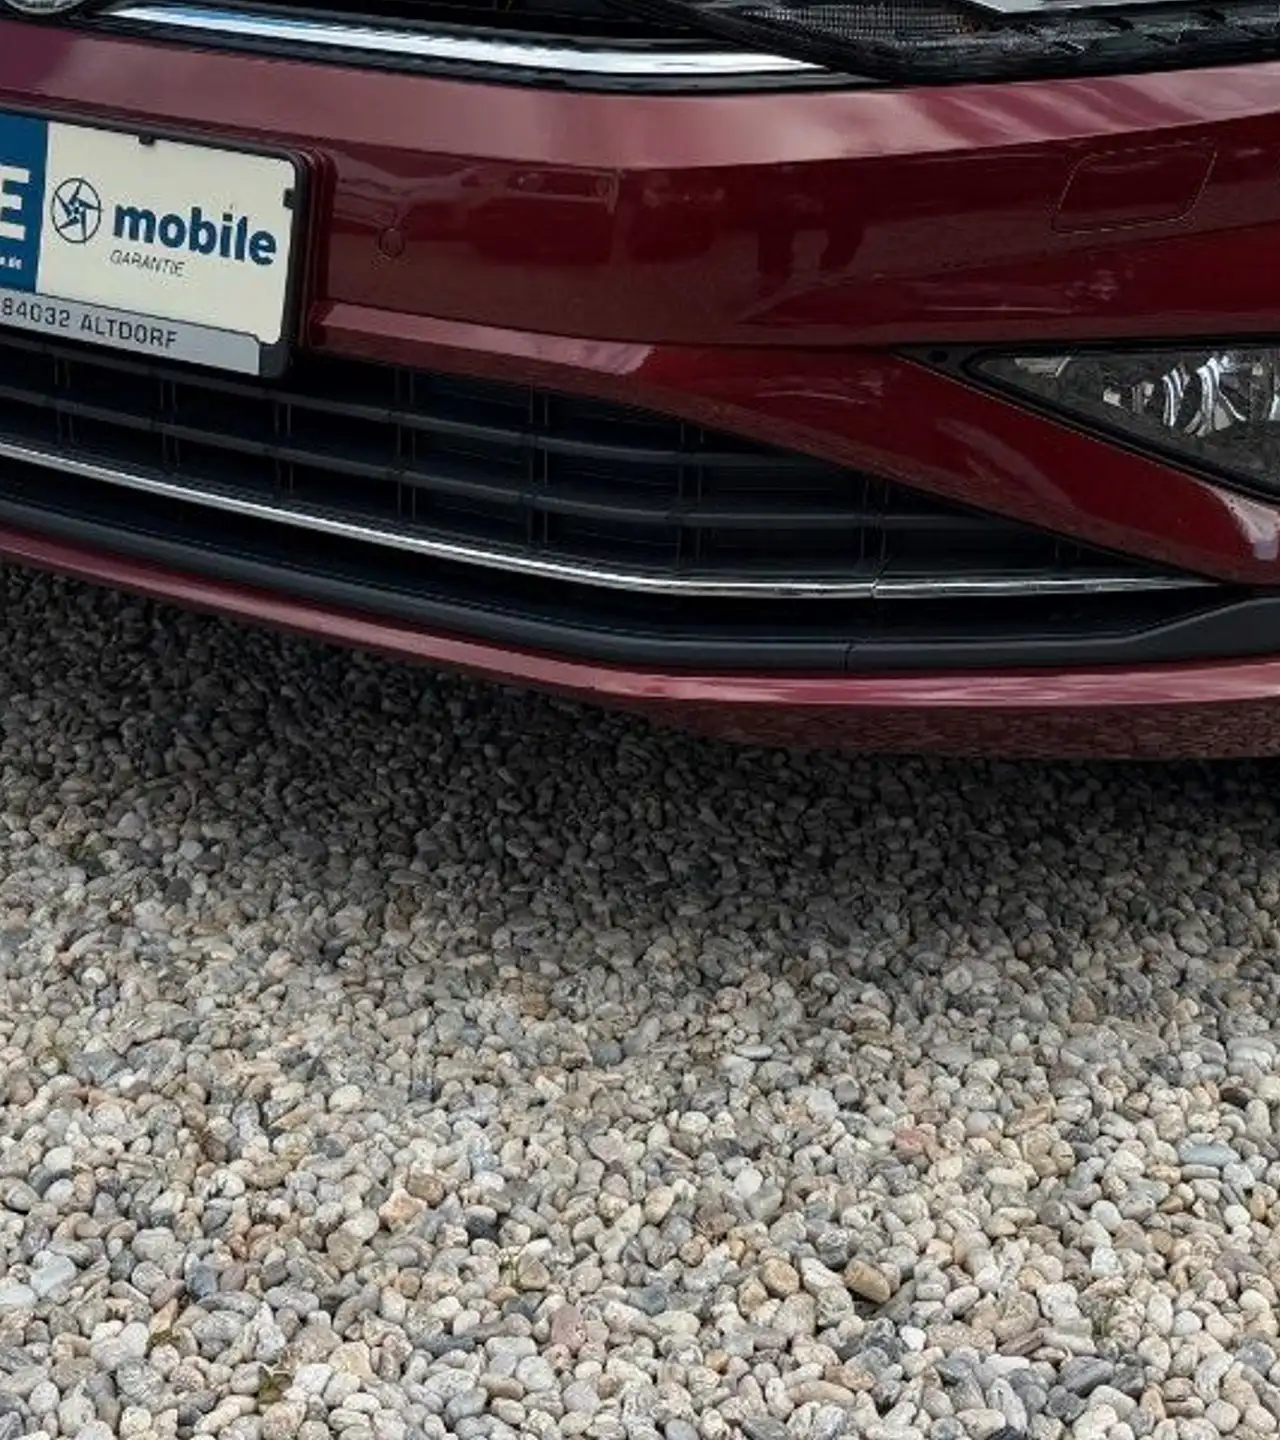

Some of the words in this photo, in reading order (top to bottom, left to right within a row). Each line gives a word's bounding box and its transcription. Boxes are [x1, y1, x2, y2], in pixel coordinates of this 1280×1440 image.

[113, 202, 277, 266] mobile
[110, 248, 185, 278] GARANTIE
[1, 296, 72, 330] 84032
[80, 313, 178, 350] ALTDORF
